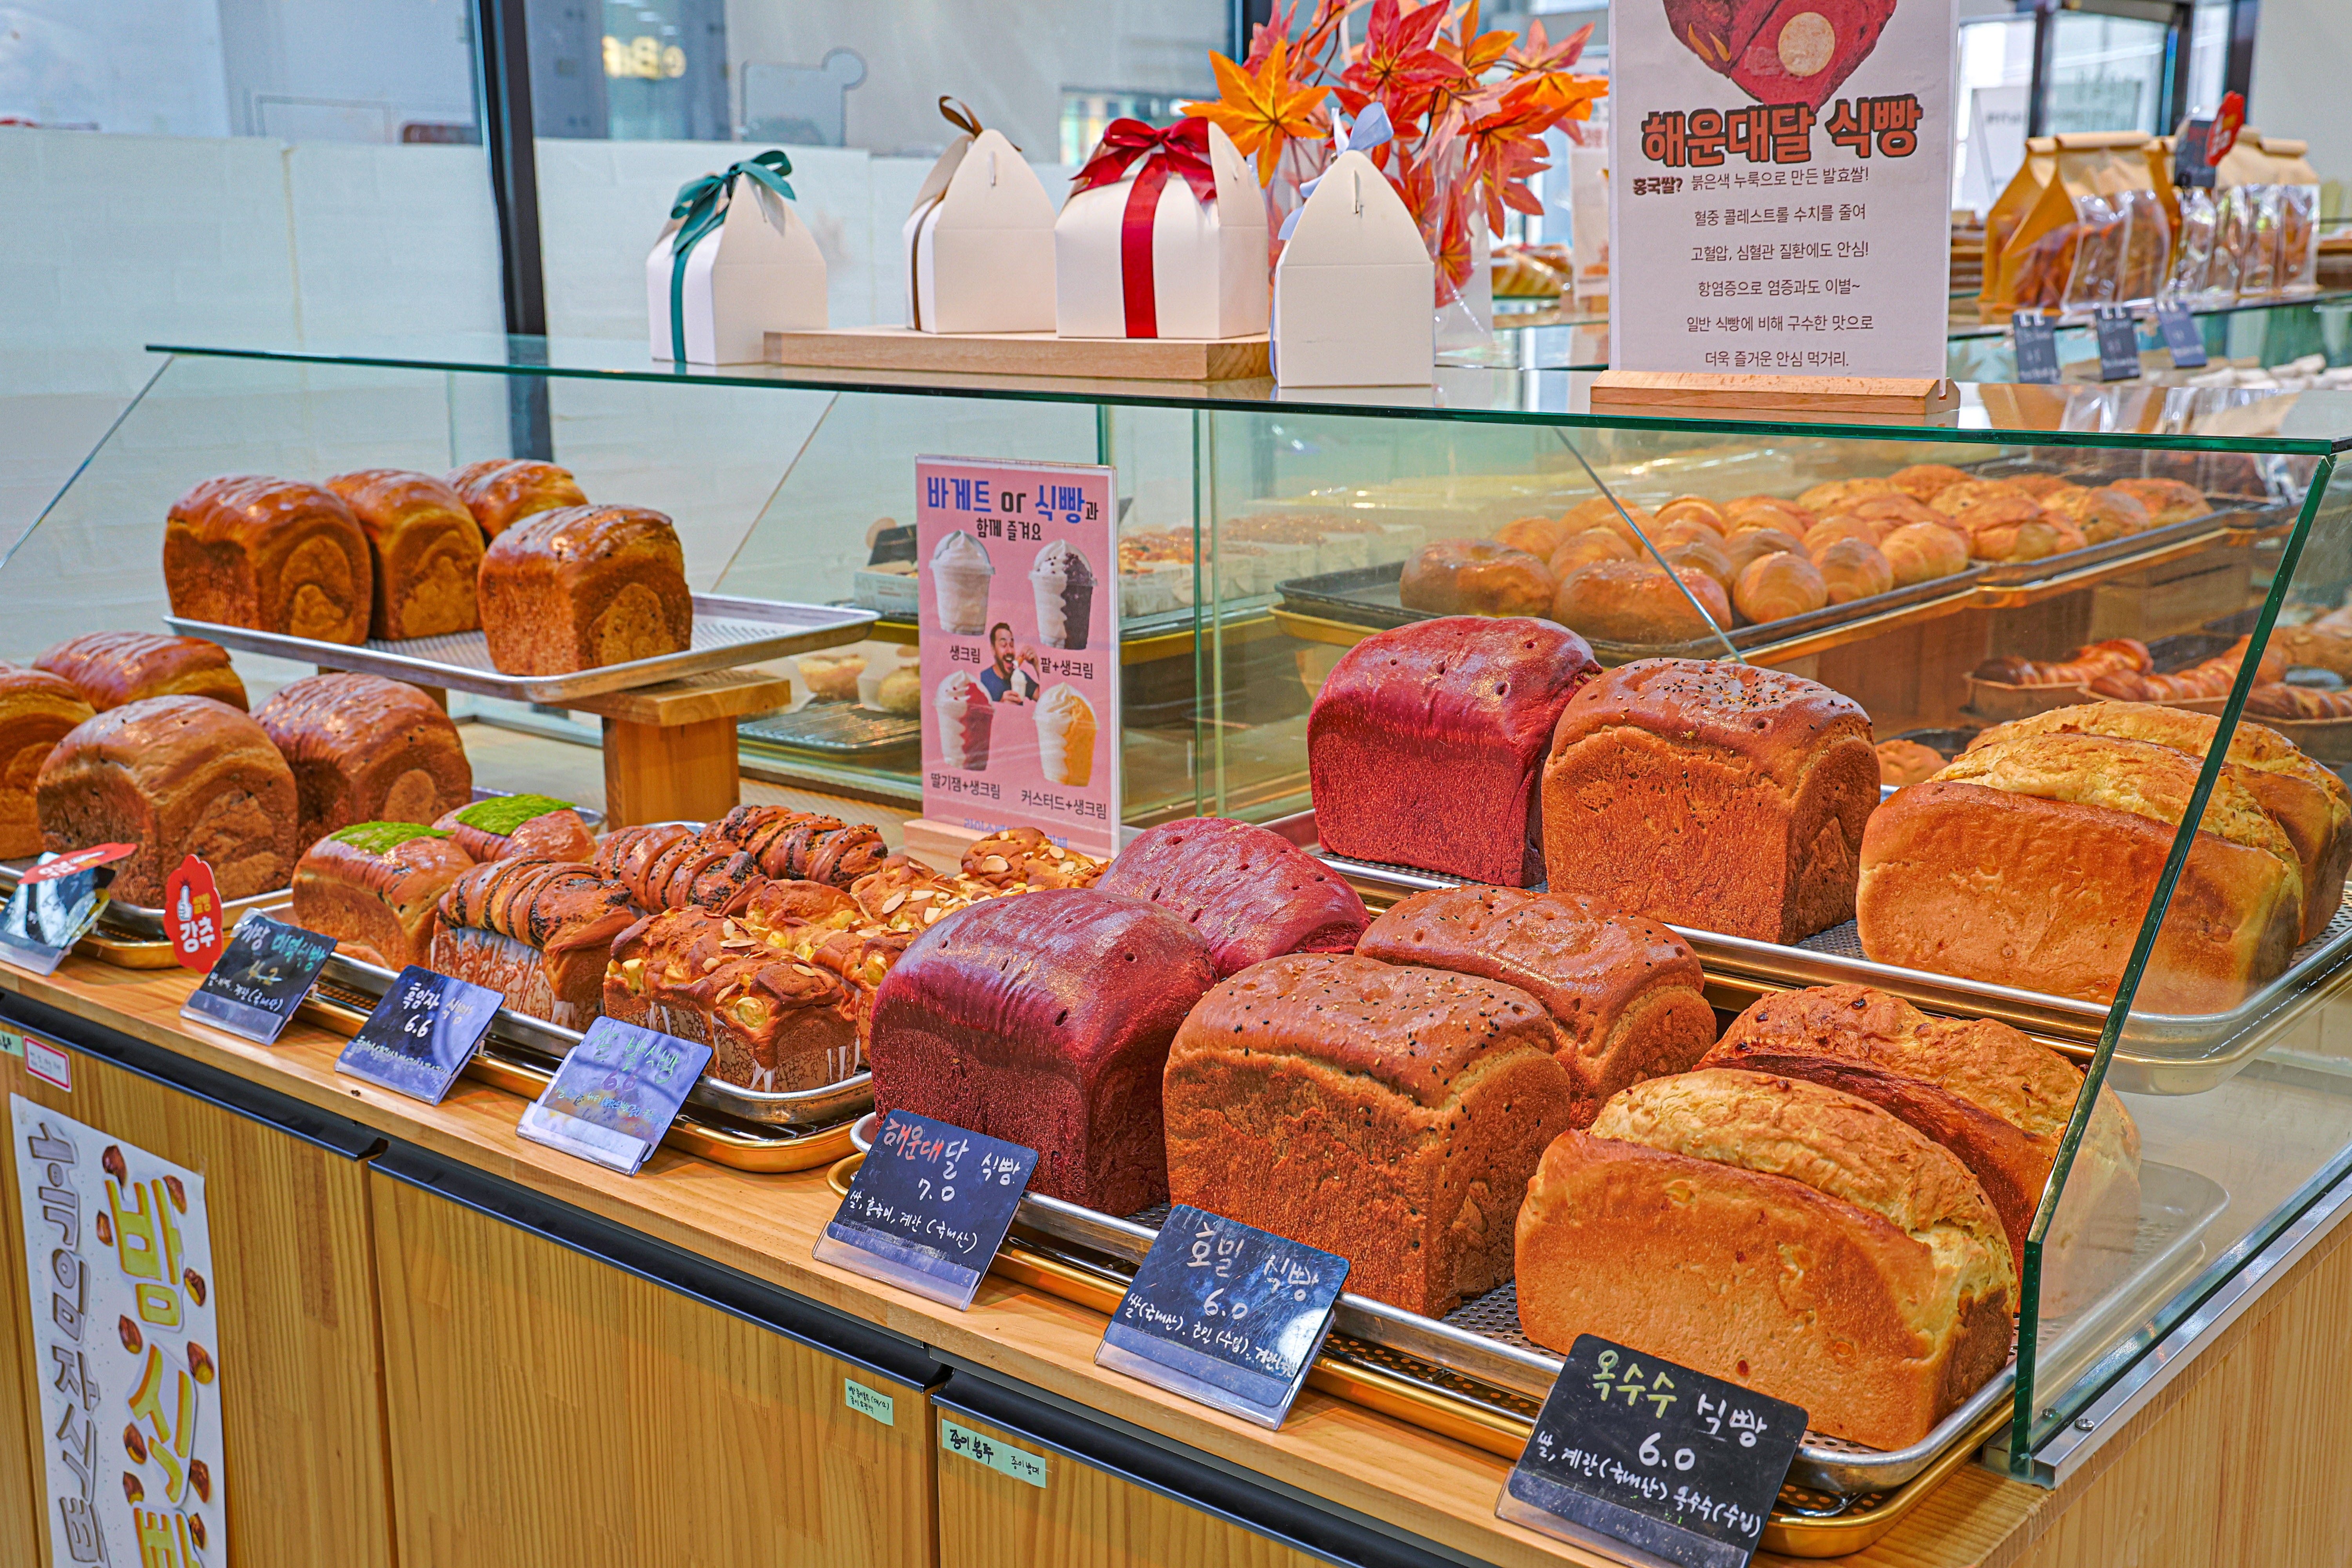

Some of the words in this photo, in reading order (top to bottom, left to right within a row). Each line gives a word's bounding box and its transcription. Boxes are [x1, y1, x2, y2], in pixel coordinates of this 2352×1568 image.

[1641, 102, 1816, 168] 해운대달
[1825, 93, 1923, 158] 식빵
[1632, 176, 1683, 196] 홍국쌀?
[1691, 172, 1730, 191] 붉은색
[1734, 171, 1787, 189] 누룩으로
[1791, 168, 1819, 185] 만든
[1822, 165, 1869, 183] 발효쌀!
[1694, 209, 1720, 226] 혈중
[1723, 206, 1789, 225] 콜레스트롤
[1793, 204, 1834, 222] 수치를
[1838, 203, 1866, 220] 줄여
[1691, 245, 1733, 261] 고혈압,
[1736, 243, 1775, 261] 심혈관
[1779, 242, 1833, 259] 질환에도
[1837, 240, 1869, 258] 안심!
[1698, 281, 1763, 298] 항염증으로
[1767, 279, 1821, 296] 염증과도
[1825, 277, 1861, 295] 이별~
[1686, 316, 1711, 332] 일반
[1715, 316, 1753, 332] 식빵에
[1758, 316, 1783, 332] 비해
[1788, 315, 1828, 332] 구수한
[1831, 315, 1874, 331] 맛으로
[1705, 351, 1730, 367] 더욱
[1734, 351, 1773, 367] 즐거운
[1776, 350, 1803, 367] 안심
[1807, 350, 1849, 367] 먹거리.
[927, 476, 992, 512] 바게트
[1001, 491, 1027, 514] or
[976, 517, 1001, 538] 함께
[1006, 520, 1042, 541] 즐겨요
[949, 645, 980, 664] 생크림
[1040, 657, 1094, 679] 팥+생크림
[931, 772, 1001, 800] 딸기잼+생크림
[1021, 789, 1107, 820] 커스터드+생크림
[179, 916, 216, 953] 강추
[404, 1014, 433, 1038] 6.6
[883, 1118, 969, 1180] 해운대달
[981, 1152, 1021, 1186] 식빵
[918, 1177, 956, 1202] 7.0
[1186, 1221, 1245, 1278] 호밀
[1263, 1254, 1320, 1302] 식빵
[1203, 1287, 1249, 1321] 6.0
[1592, 1348, 1678, 1419] 옥수수
[1696, 1393, 1768, 1448] 식빵
[1638, 1432, 1697, 1471] 6.0
